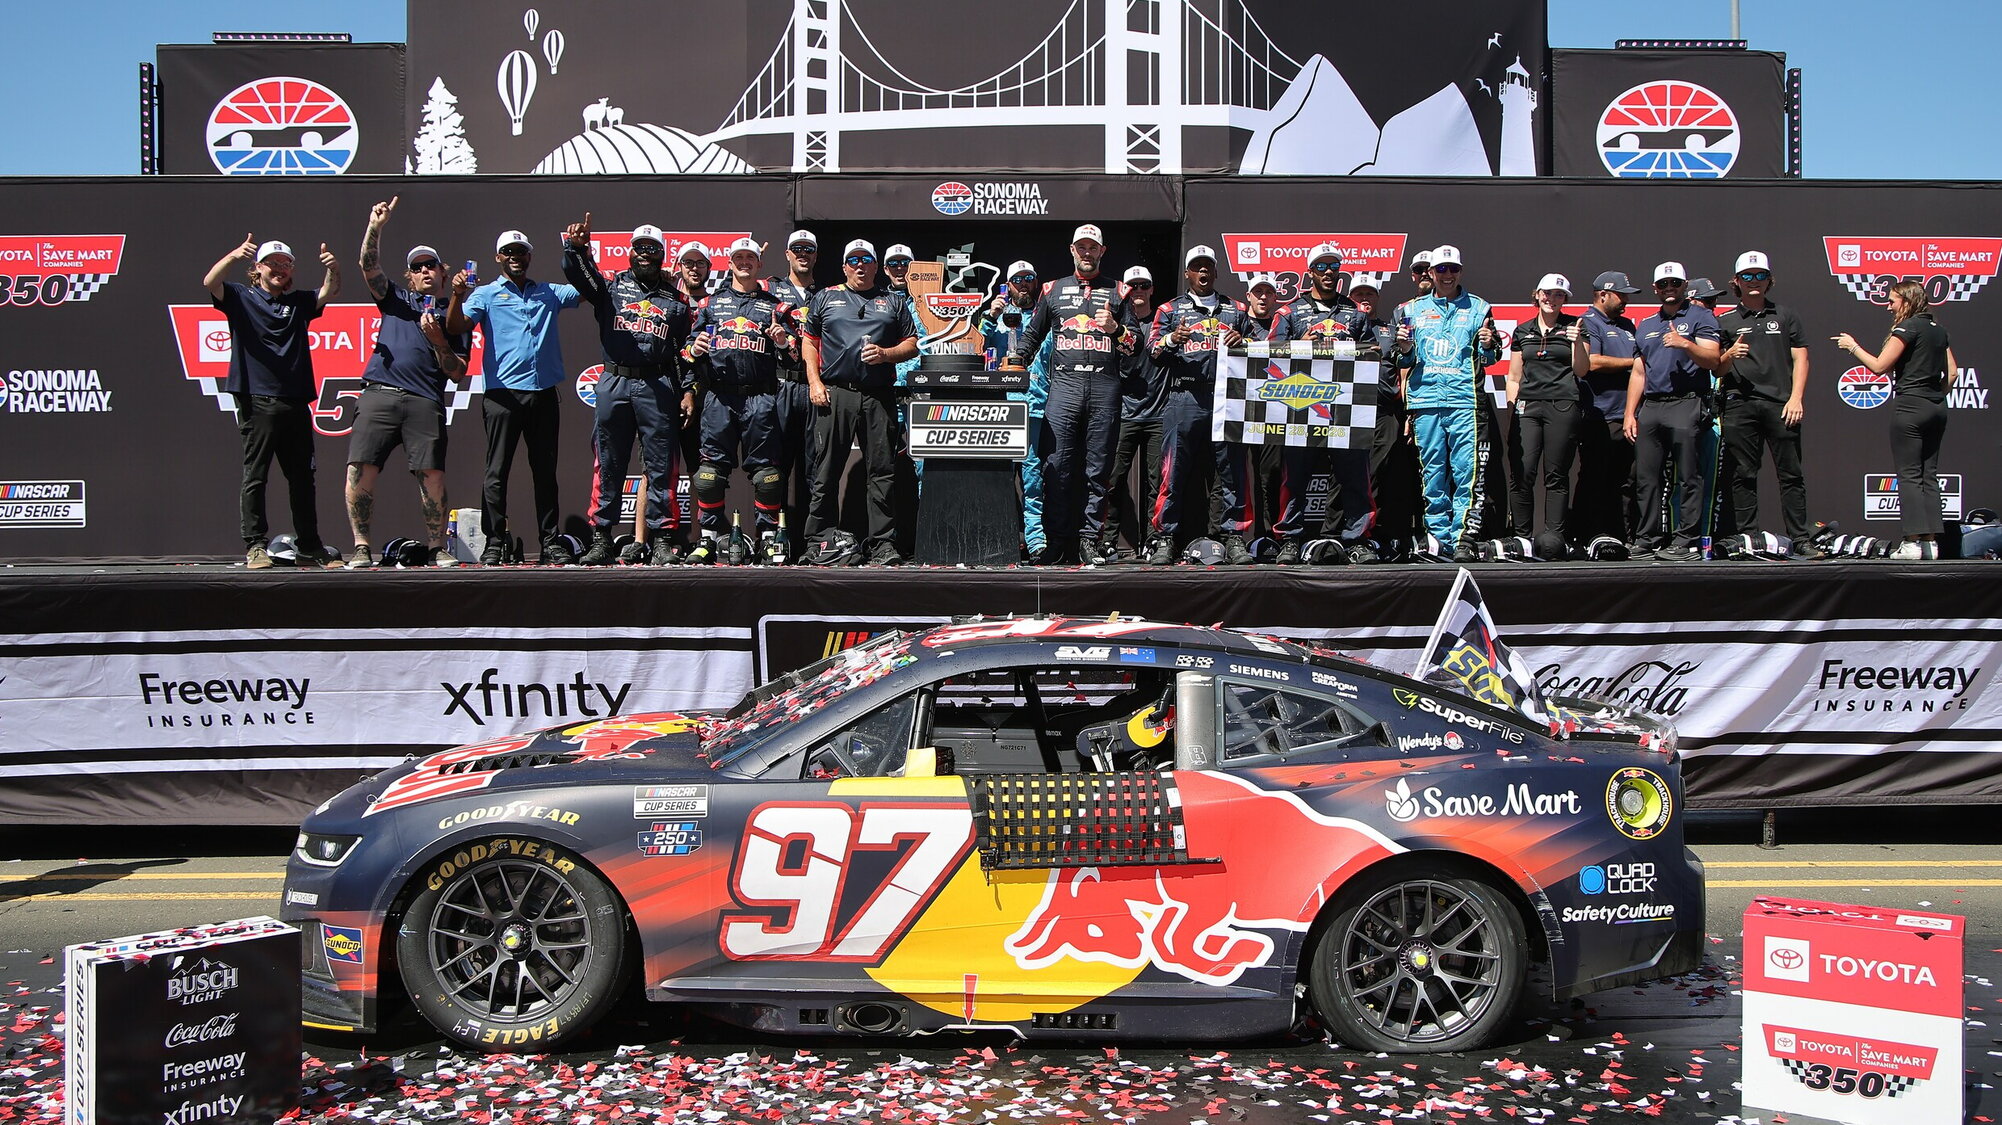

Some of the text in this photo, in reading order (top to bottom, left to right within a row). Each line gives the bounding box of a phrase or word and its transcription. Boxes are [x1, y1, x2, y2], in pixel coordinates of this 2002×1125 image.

[974, 182, 1041, 199] SONOMA
[974, 199, 1048, 215] RACEWAY
[0, 249, 113, 260] YOTA SAVE MART
[605, 246, 632, 257] TOY
[708, 247, 731, 258] MAR
[1265, 247, 1395, 258] TOYOT AVE MART
[1864, 250, 1993, 262] TOYOTA SAVE MART
[1870, 274, 1952, 306] 30
[941, 306, 966, 315] 350
[613, 315, 669, 340] Red Bull
[308, 331, 353, 350] OTA
[715, 333, 766, 353] Red Bull
[1056, 334, 1111, 353] Red Bull
[9, 370, 102, 391] SONOMA
[1001, 375, 1022, 383] xfinity
[1262, 383, 1337, 400] SUNOCO
[10, 391, 112, 413] RACEWAY
[947, 405, 1010, 421] NASCAR
[926, 430, 1011, 445] CUP SERIES
[1248, 423, 1285, 435] JUNE
[14, 484, 70, 498] NASCAR
[24, 505, 71, 517] SERIES
[621, 500, 636, 512] CU
[1054, 646, 1112, 658] SVG
[1229, 664, 1290, 681] SIEMENS
[1819, 659, 1981, 698] Freeway
[139, 673, 310, 710] Freeway
[440, 667, 632, 725] xfinity
[1815, 698, 1968, 713] INSURANCE
[148, 712, 315, 728] INSURANCE
[1398, 732, 1443, 753] Wendy's
[657, 787, 697, 797] NASCAR
[1423, 783, 1582, 818] Save Mart
[644, 801, 697, 811] CUP SERIES
[1608, 779, 1626, 830] TRACKHOUSE
[1653, 777, 1671, 827] TRACKHOUSE
[438, 800, 581, 830] GOODYEAR
[653, 831, 688, 845] 250
[427, 838, 576, 891] GOODYEAR
[1607, 862, 1655, 879] QUAD
[718, 802, 976, 963] 97
[1607, 877, 1656, 894] LOCK
[1561, 902, 1675, 925] SafetyCulture
[326, 938, 359, 951] SUNOCO
[1819, 953, 1937, 987] TOYOTA
[167, 966, 239, 1000] BUSCH
[180, 990, 224, 1006] LIGHT
[75, 959, 85, 1105] CUP SERIES
[165, 1011, 240, 1049] Coca-Cola
[482, 1016, 560, 1045] EAGLE
[1800, 1039, 1928, 1068] TOYOTA SAVE MART
[1861, 1042, 1873, 1050] The
[164, 1051, 246, 1081] Freeway
[1861, 1059, 1899, 1070] COMPANIES
[164, 1069, 246, 1093] INSURANCE
[1803, 1063, 1886, 1100] 350
[163, 1094, 244, 1125] xfinity
